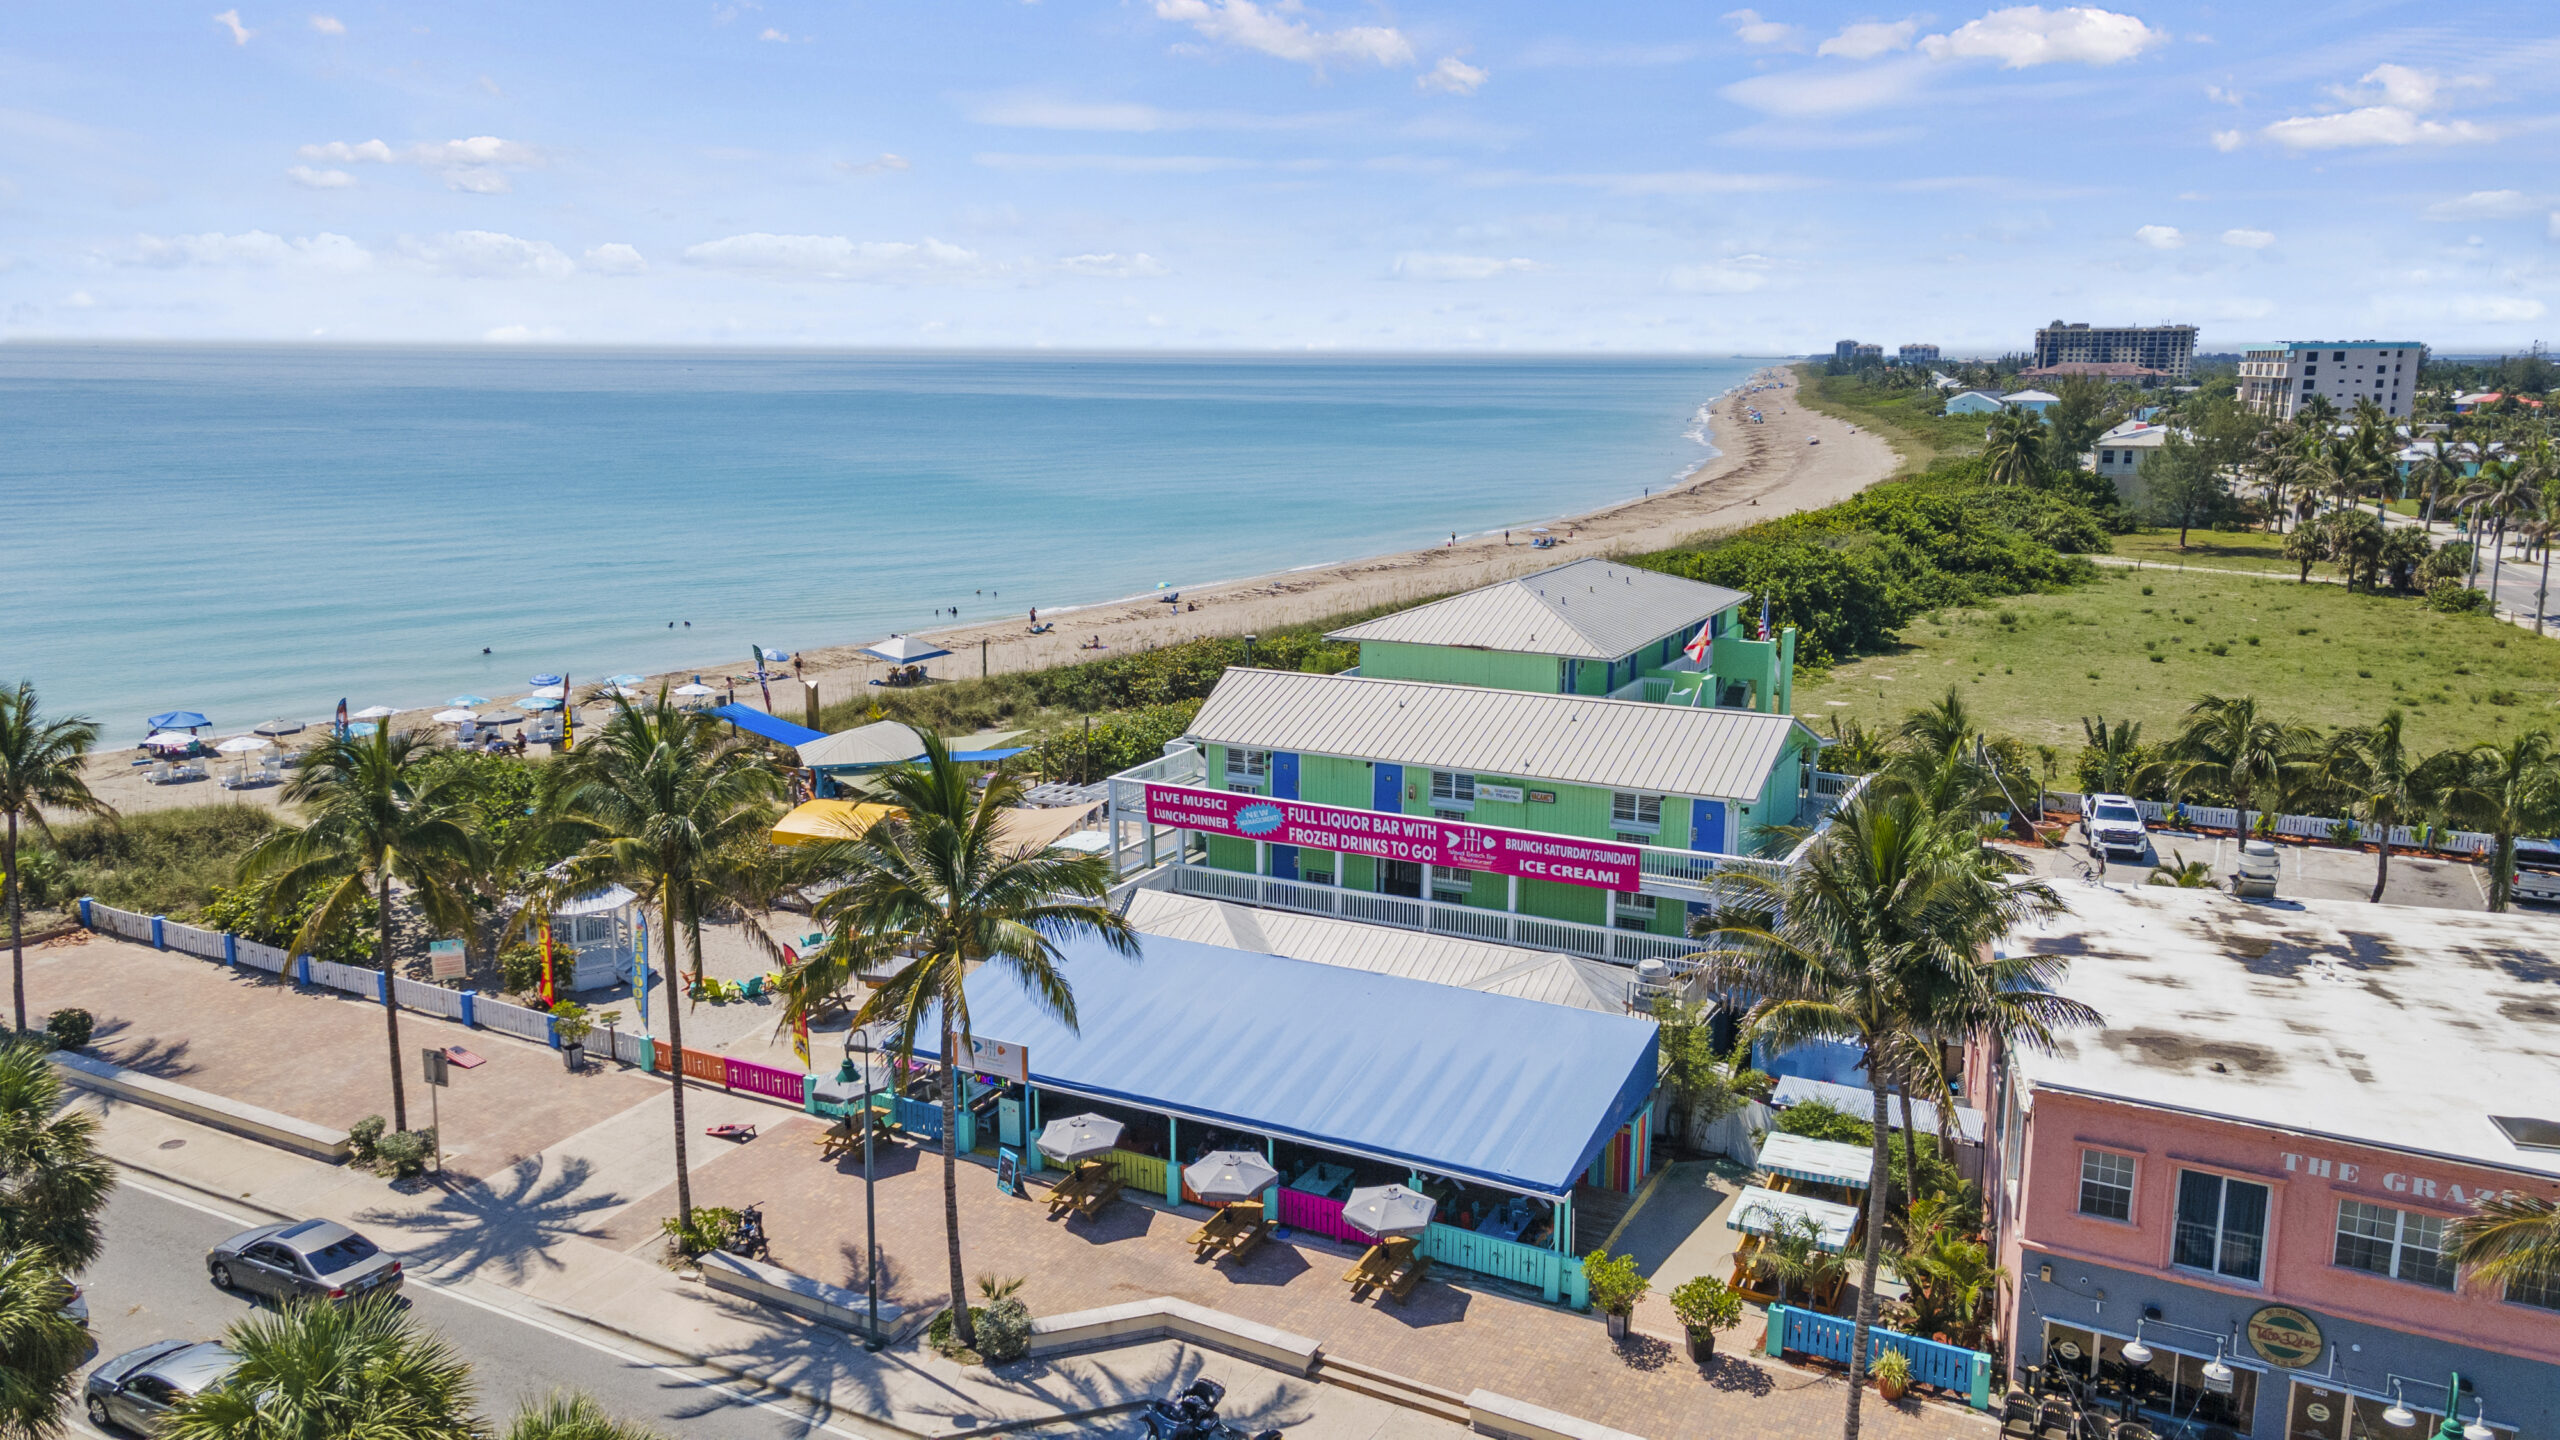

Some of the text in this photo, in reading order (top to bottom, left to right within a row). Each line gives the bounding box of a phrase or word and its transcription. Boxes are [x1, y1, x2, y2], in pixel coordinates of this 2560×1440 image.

[1153, 790, 1227, 811] LIVE MUSIC!
[1245, 809, 1269, 819] NEW
[1154, 807, 1229, 829] LUNCH-DINNER
[1288, 806, 1437, 840] FULL LIQUOR BAR WITH
[1288, 827, 1437, 861] FROZEN DRINKS TO GO!
[1505, 837, 1636, 867] BRUNCH SATURDAY/SUNDAY!
[1519, 859, 1620, 884] ICE CREAM!
[2281, 1152, 2359, 1183] THE
